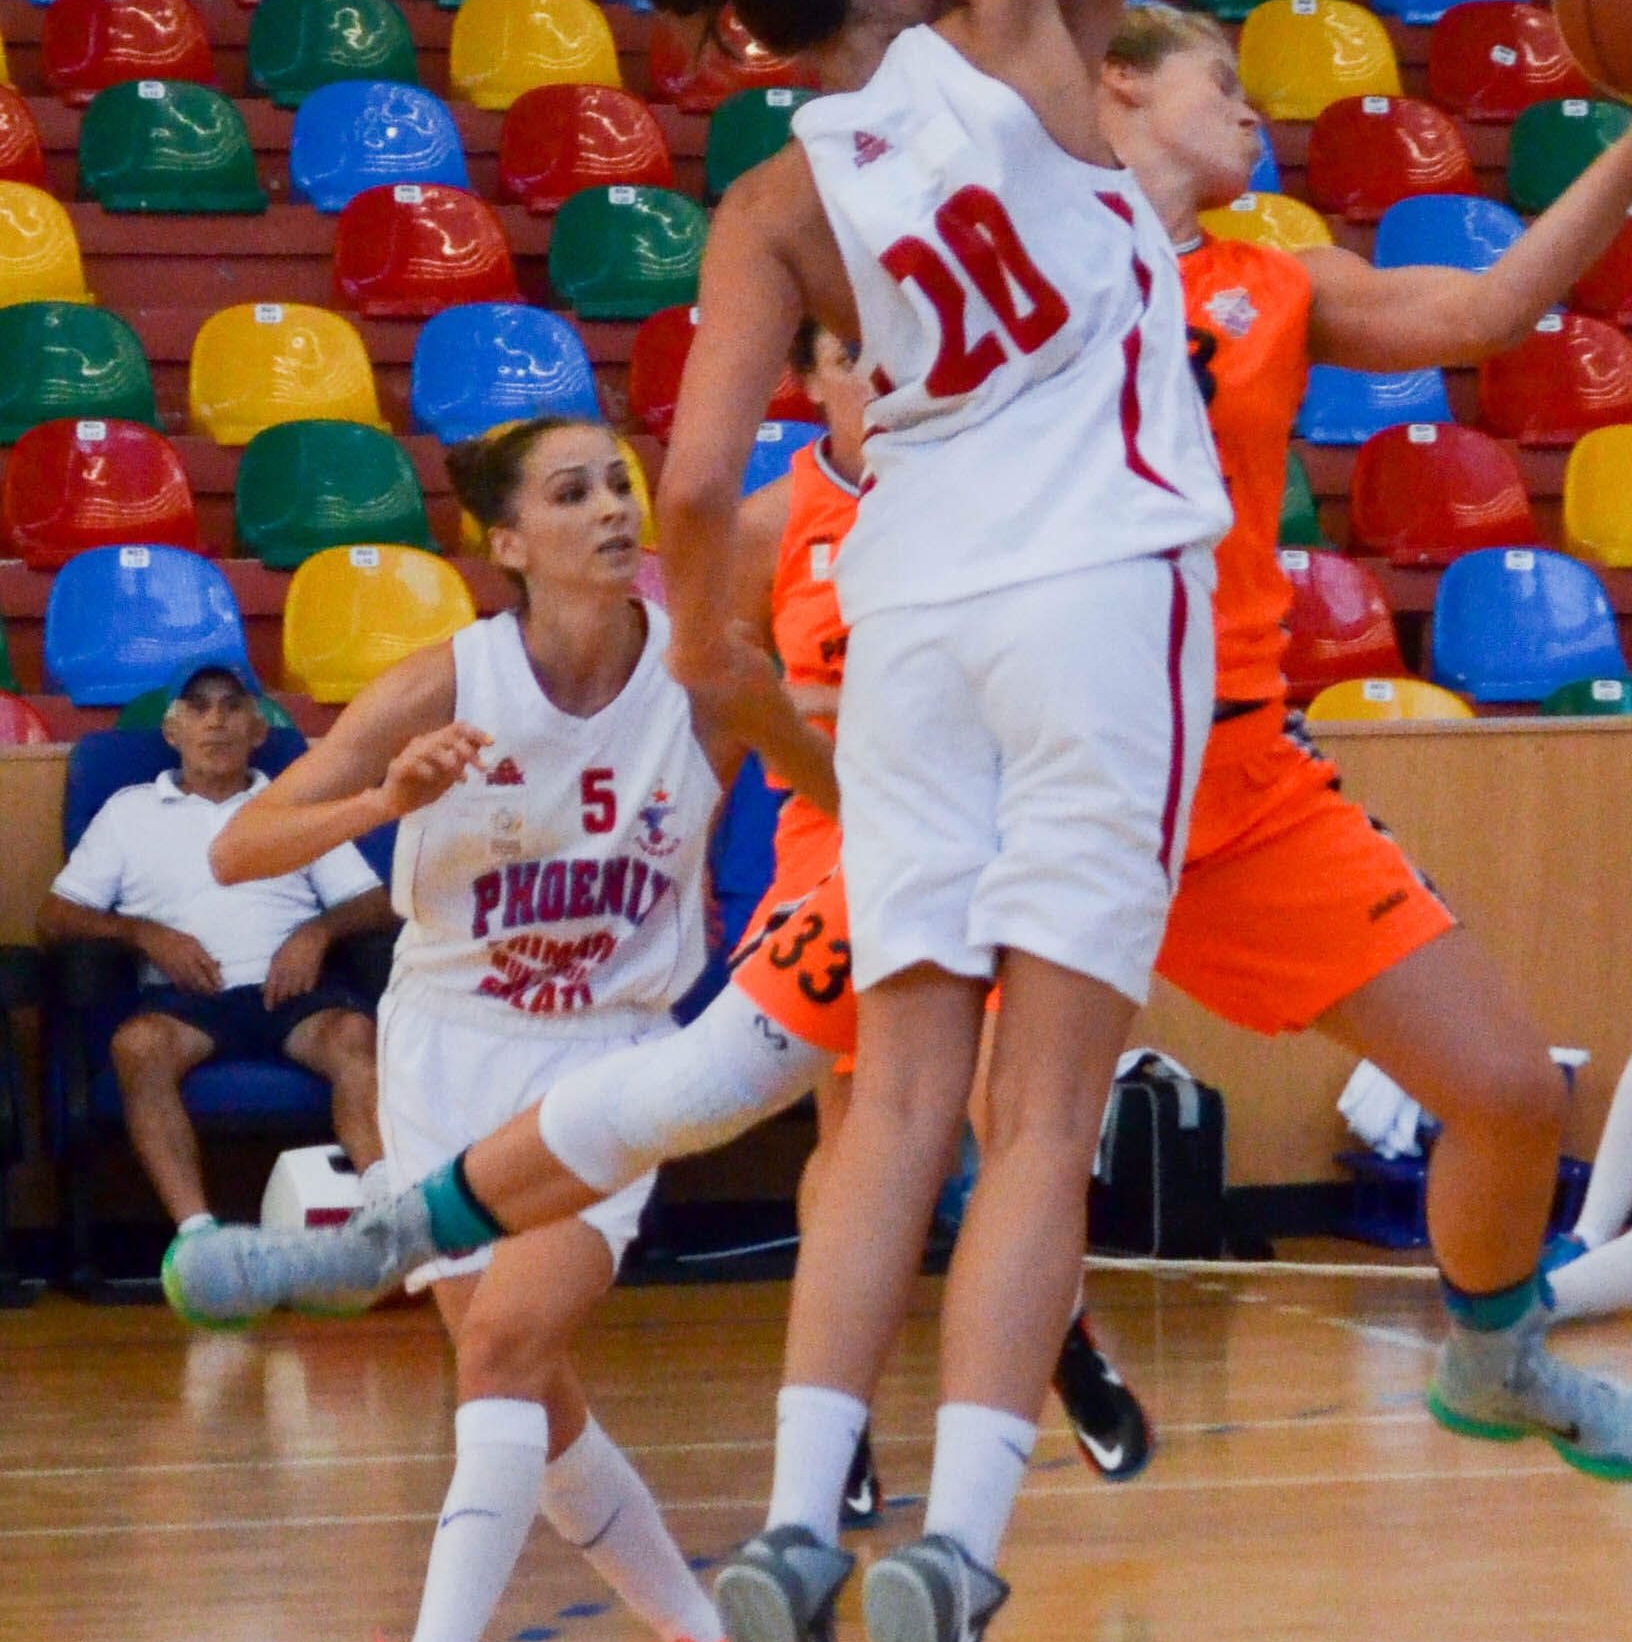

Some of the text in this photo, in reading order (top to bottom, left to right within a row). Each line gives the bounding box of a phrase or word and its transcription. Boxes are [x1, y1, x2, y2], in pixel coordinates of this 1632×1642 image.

[878, 183, 1070, 399] 20
[581, 767, 617, 834] 5
[770, 912, 853, 1004] 33
